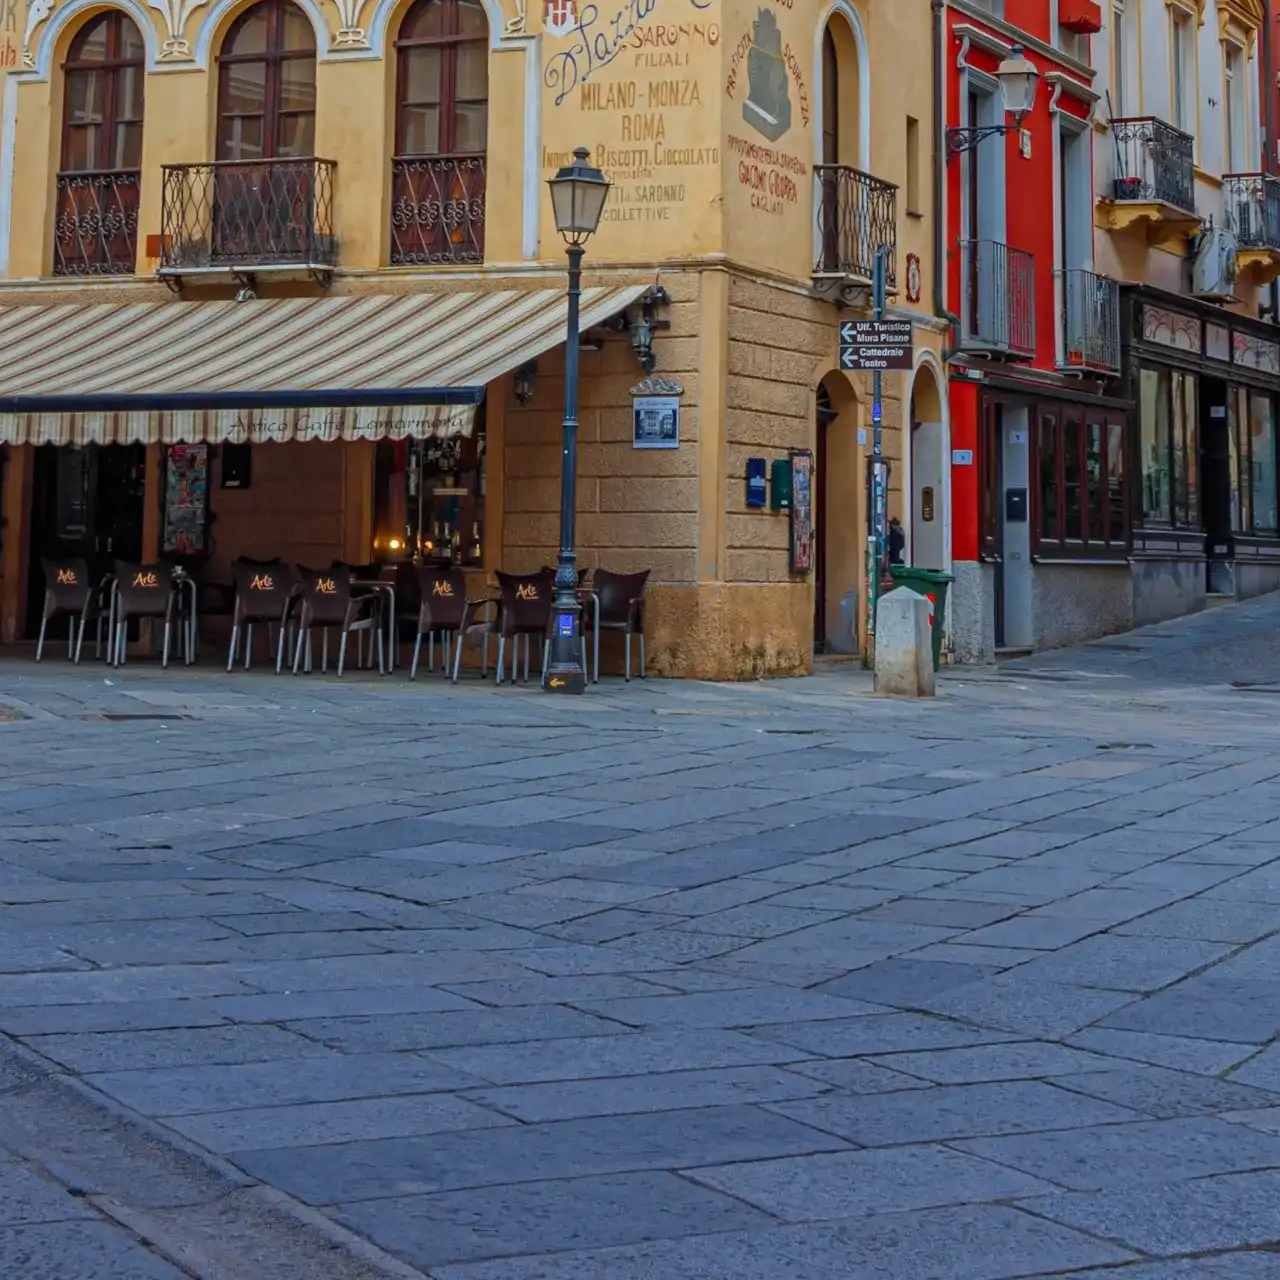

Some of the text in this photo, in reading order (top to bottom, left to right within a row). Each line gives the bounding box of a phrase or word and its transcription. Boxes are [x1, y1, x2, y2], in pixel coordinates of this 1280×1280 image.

[630, 22, 720, 47] SARONNO
[634, 52, 690, 67] FILIALI
[580, 80, 636, 111] MILANO
[648, 80, 701, 108] MONZA
[621, 114, 666, 142] ROMA
[654, 142, 719, 167] CIOCCOLATO
[634, 183, 685, 203] SARONNO
[873, 323, 910, 331] Turistico
[860, 348, 903, 356] Cattedrale
[227, 416, 288, 436] Antico
[352, 413, 465, 431] Lamarmora
[57, 569, 76, 584] Arte
[133, 572, 156, 587] Arte
[250, 574, 273, 590] Arte
[316, 578, 336, 594] Arte
[433, 580, 452, 596] Arte
[516, 584, 537, 600] Arte
